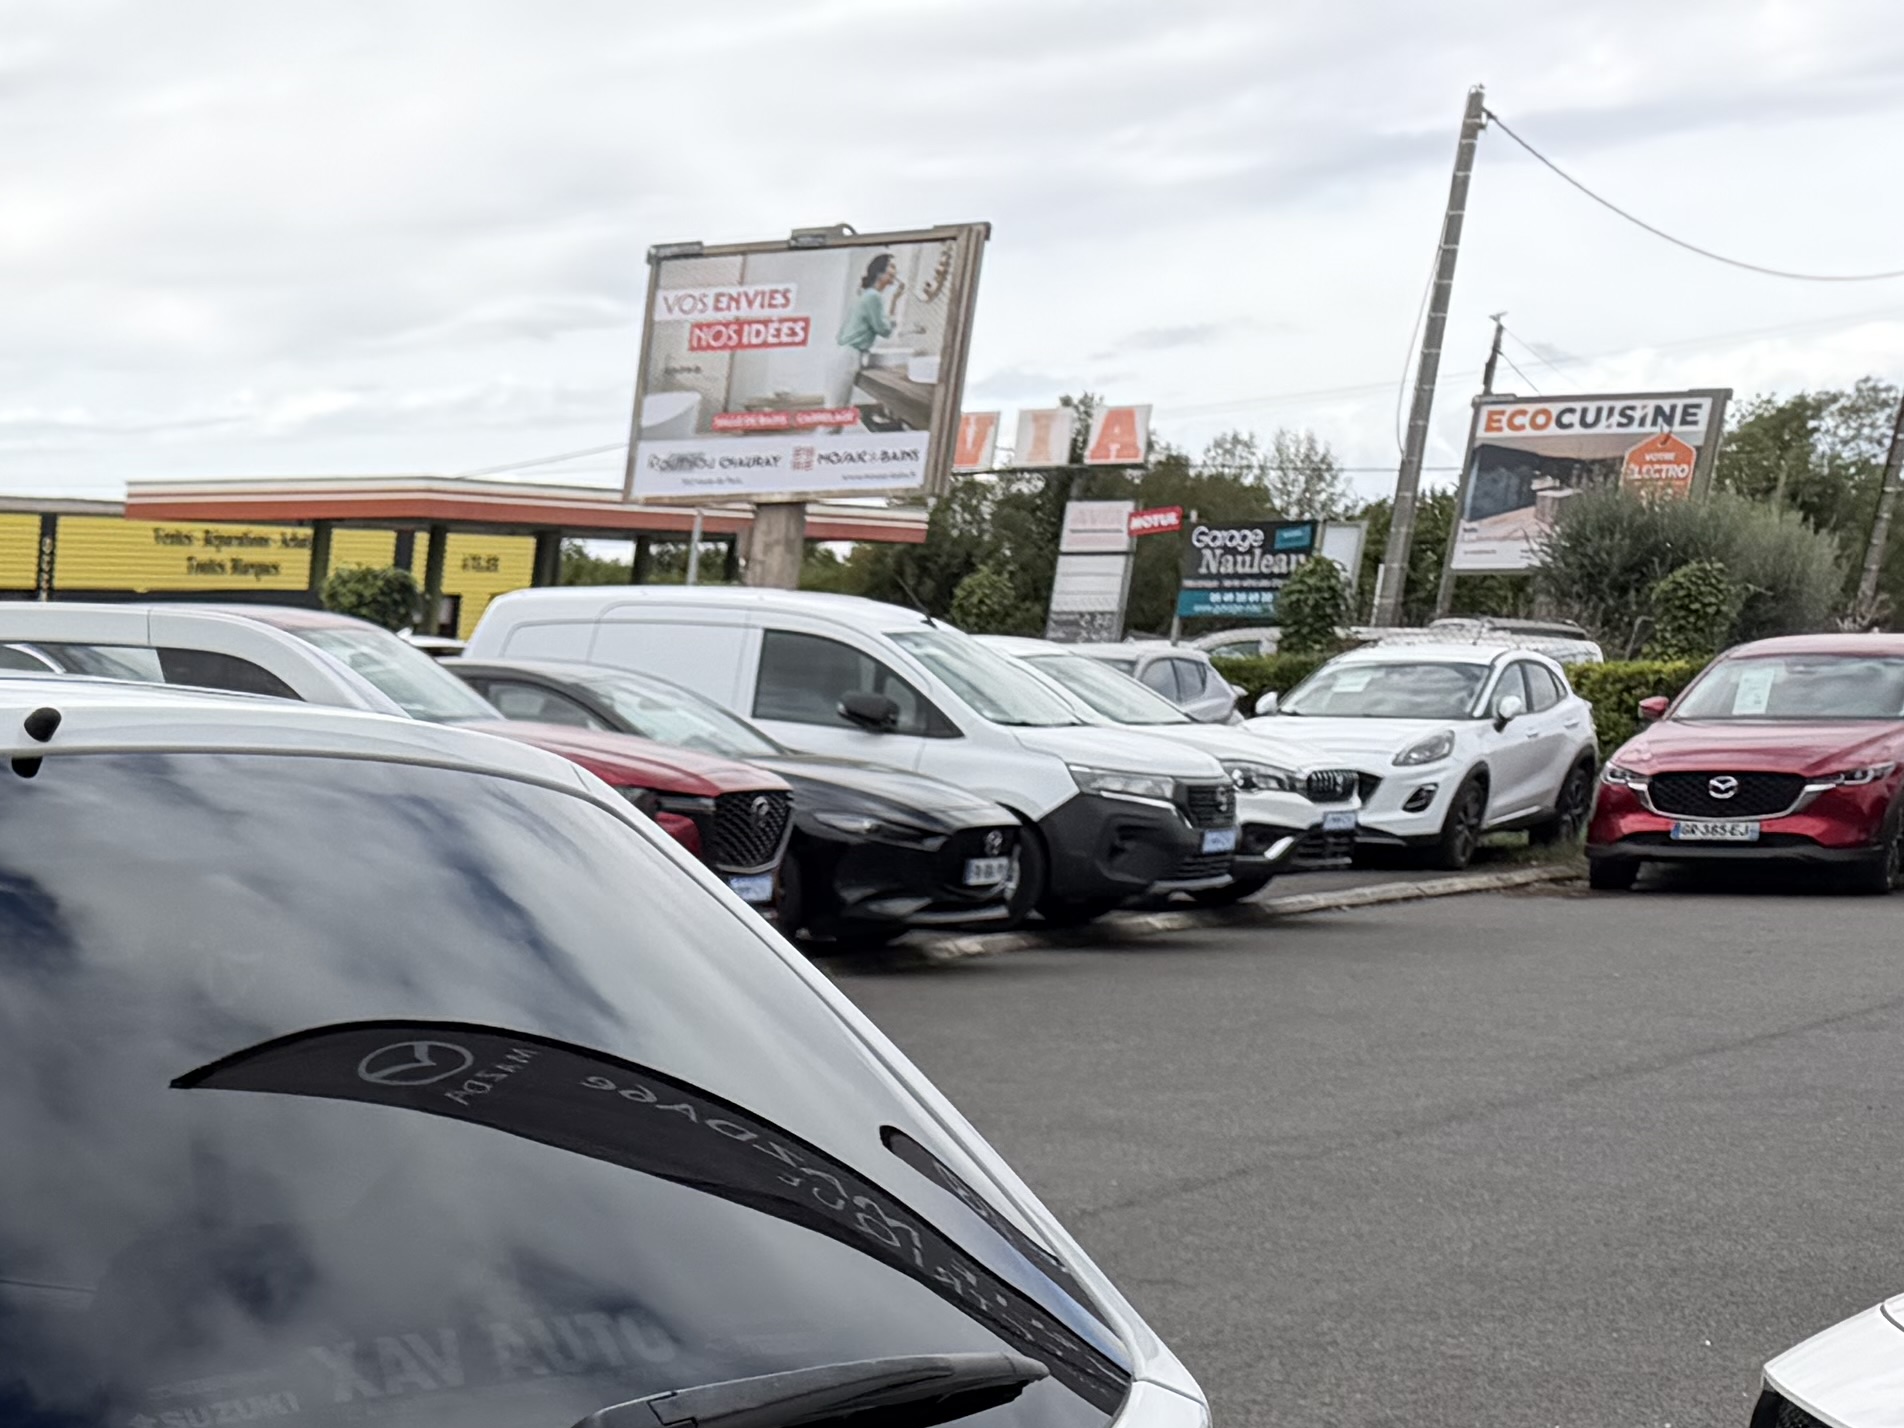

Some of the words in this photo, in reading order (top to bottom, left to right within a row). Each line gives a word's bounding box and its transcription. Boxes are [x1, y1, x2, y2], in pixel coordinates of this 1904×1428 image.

[663, 293, 709, 315] VOS
[713, 288, 792, 313] ENVIES
[692, 324, 740, 348] NOS
[743, 318, 806, 345] IDÉES
[1130, 511, 1180, 531] MOTUL
[1192, 525, 1265, 552] Garage
